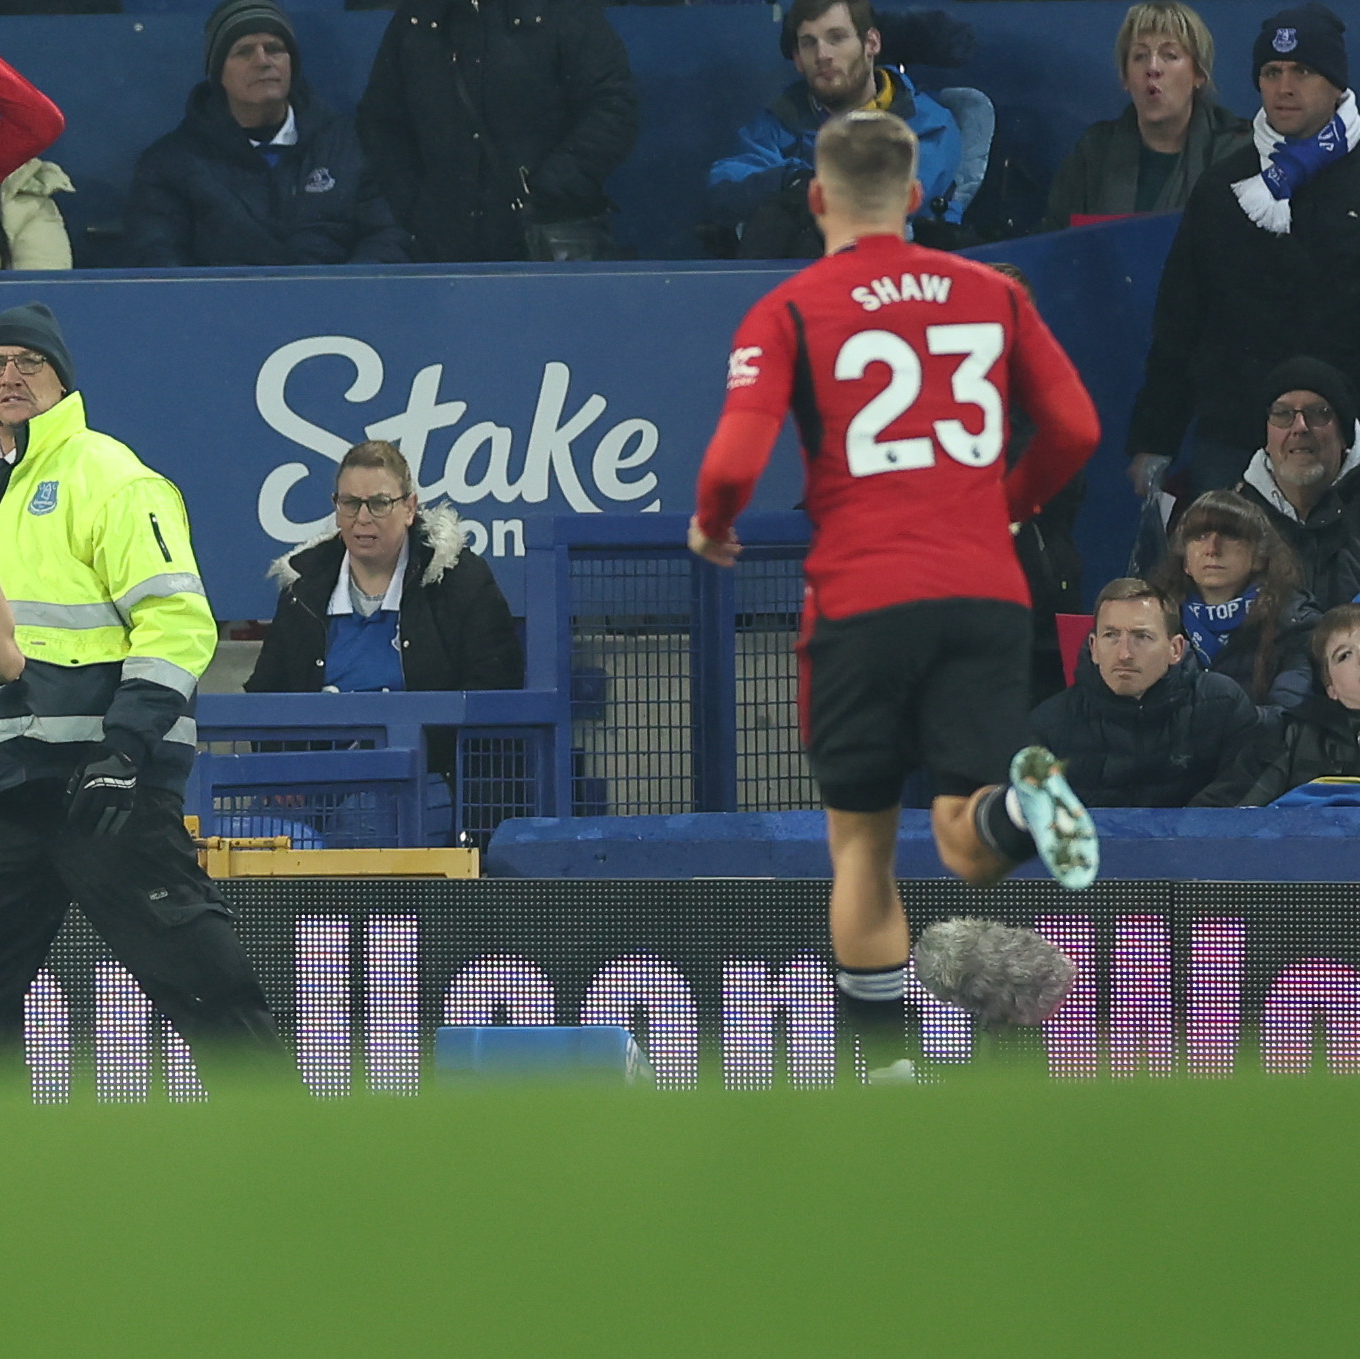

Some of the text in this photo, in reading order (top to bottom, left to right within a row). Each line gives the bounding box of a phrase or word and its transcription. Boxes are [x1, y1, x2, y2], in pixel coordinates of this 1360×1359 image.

[851, 273, 953, 312] SHAW
[255, 334, 661, 544] Stake
[834, 322, 1005, 478] 23
